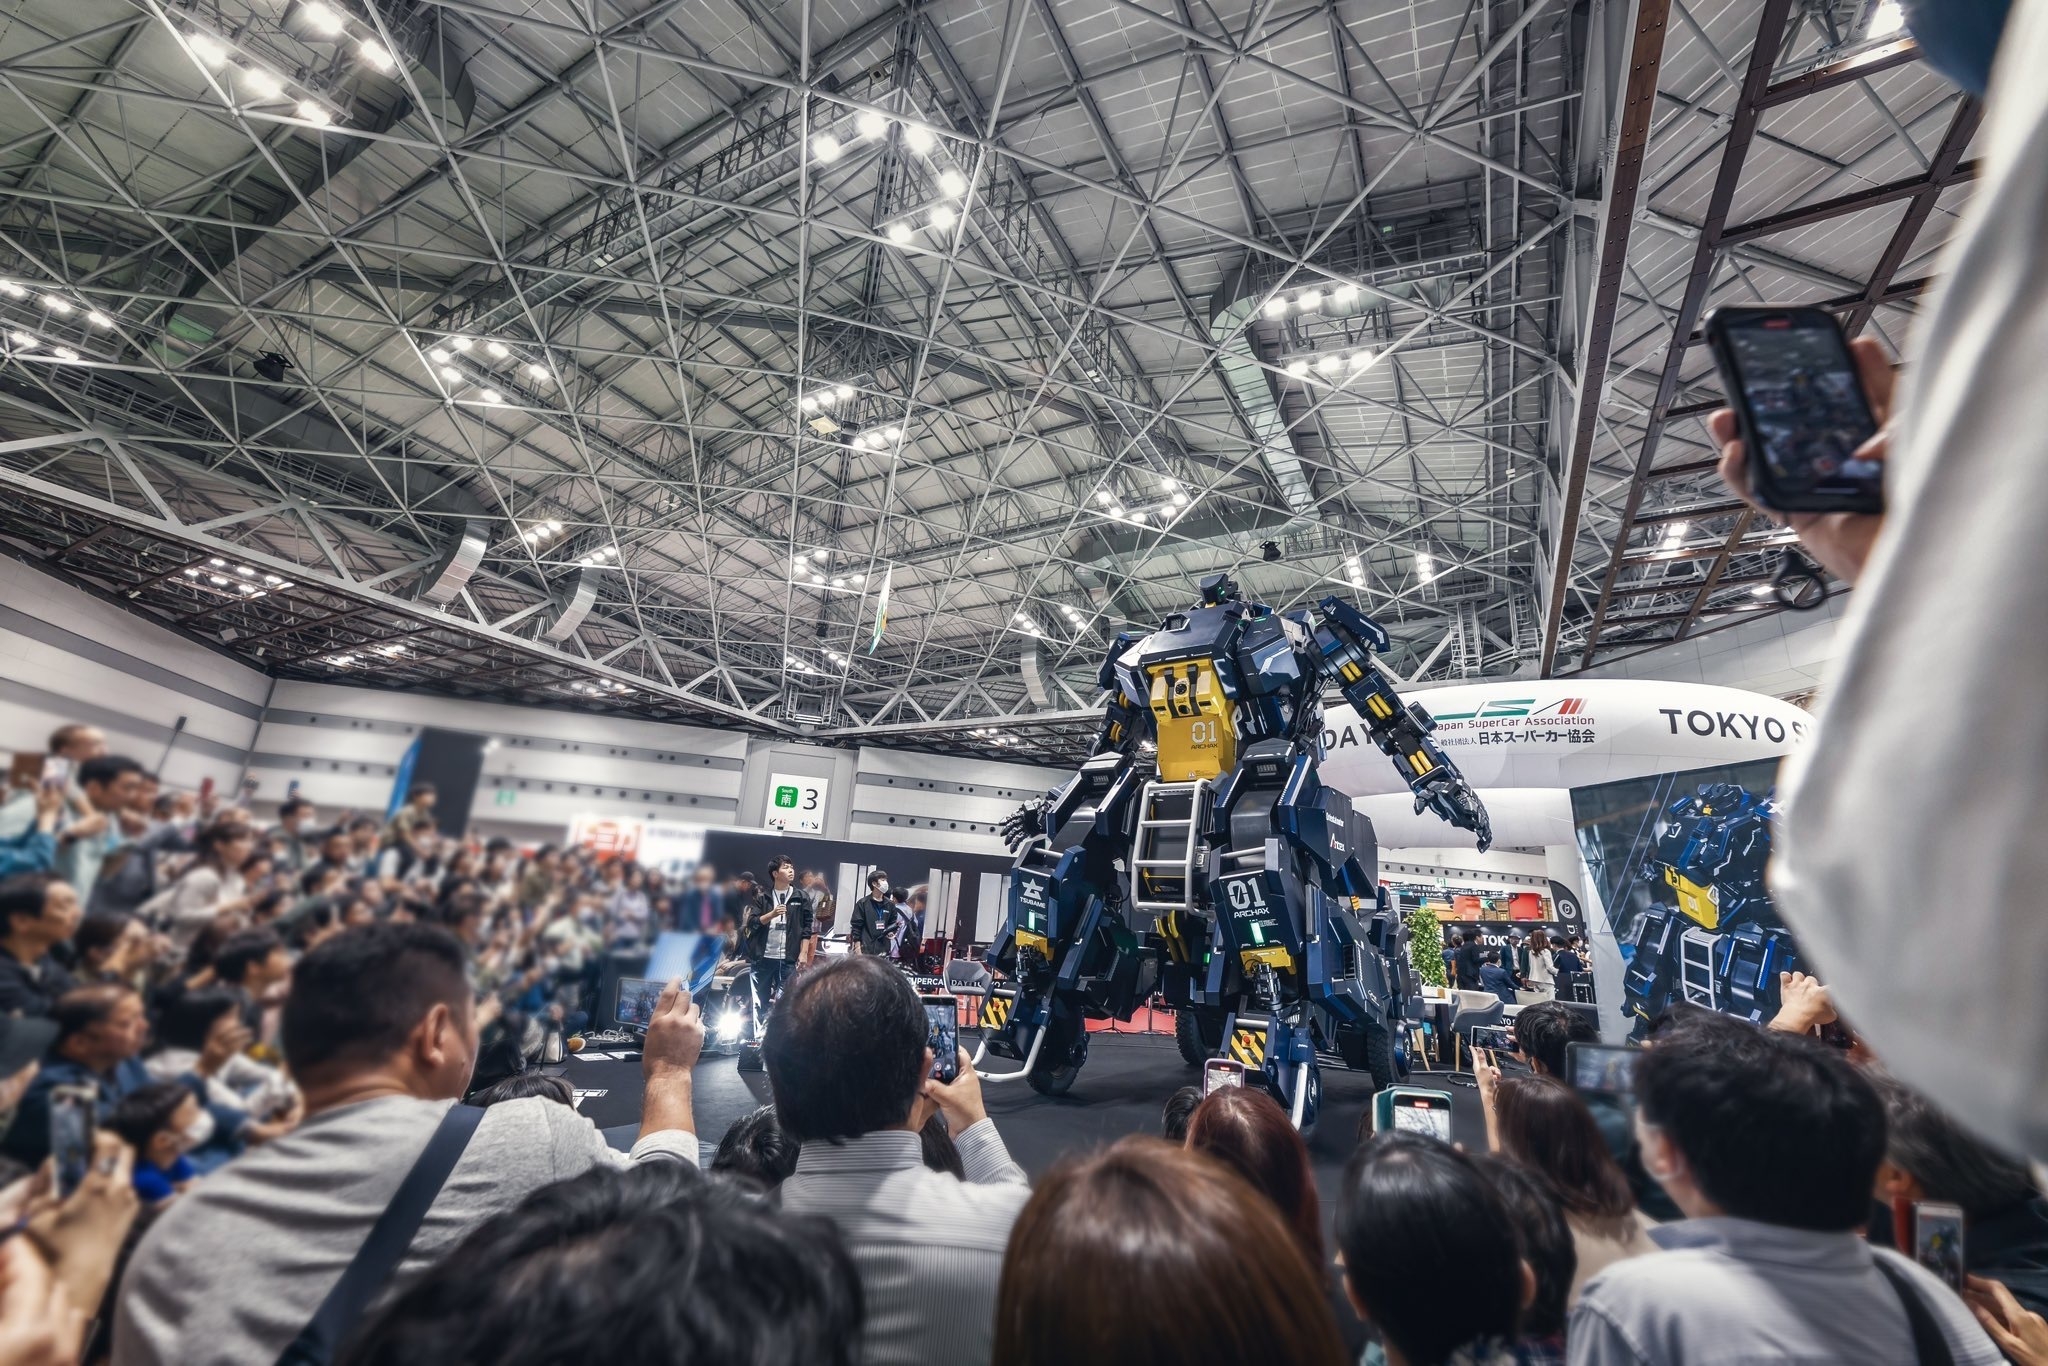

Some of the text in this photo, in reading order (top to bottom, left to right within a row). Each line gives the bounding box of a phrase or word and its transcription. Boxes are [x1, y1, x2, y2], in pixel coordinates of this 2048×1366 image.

[1433, 715, 1595, 731] apan SuperCar Association
[1659, 708, 1786, 743] TOKYO
[1192, 720, 1217, 744] 01
[1478, 729, 1596, 745] 日本スーパーカー協会
[781, 794, 792, 806] 南
[803, 788, 819, 810] 3
[1227, 877, 1266, 910] 01
[1020, 896, 1046, 909] TSUBAME
[1233, 907, 1270, 919] ARCHAX
